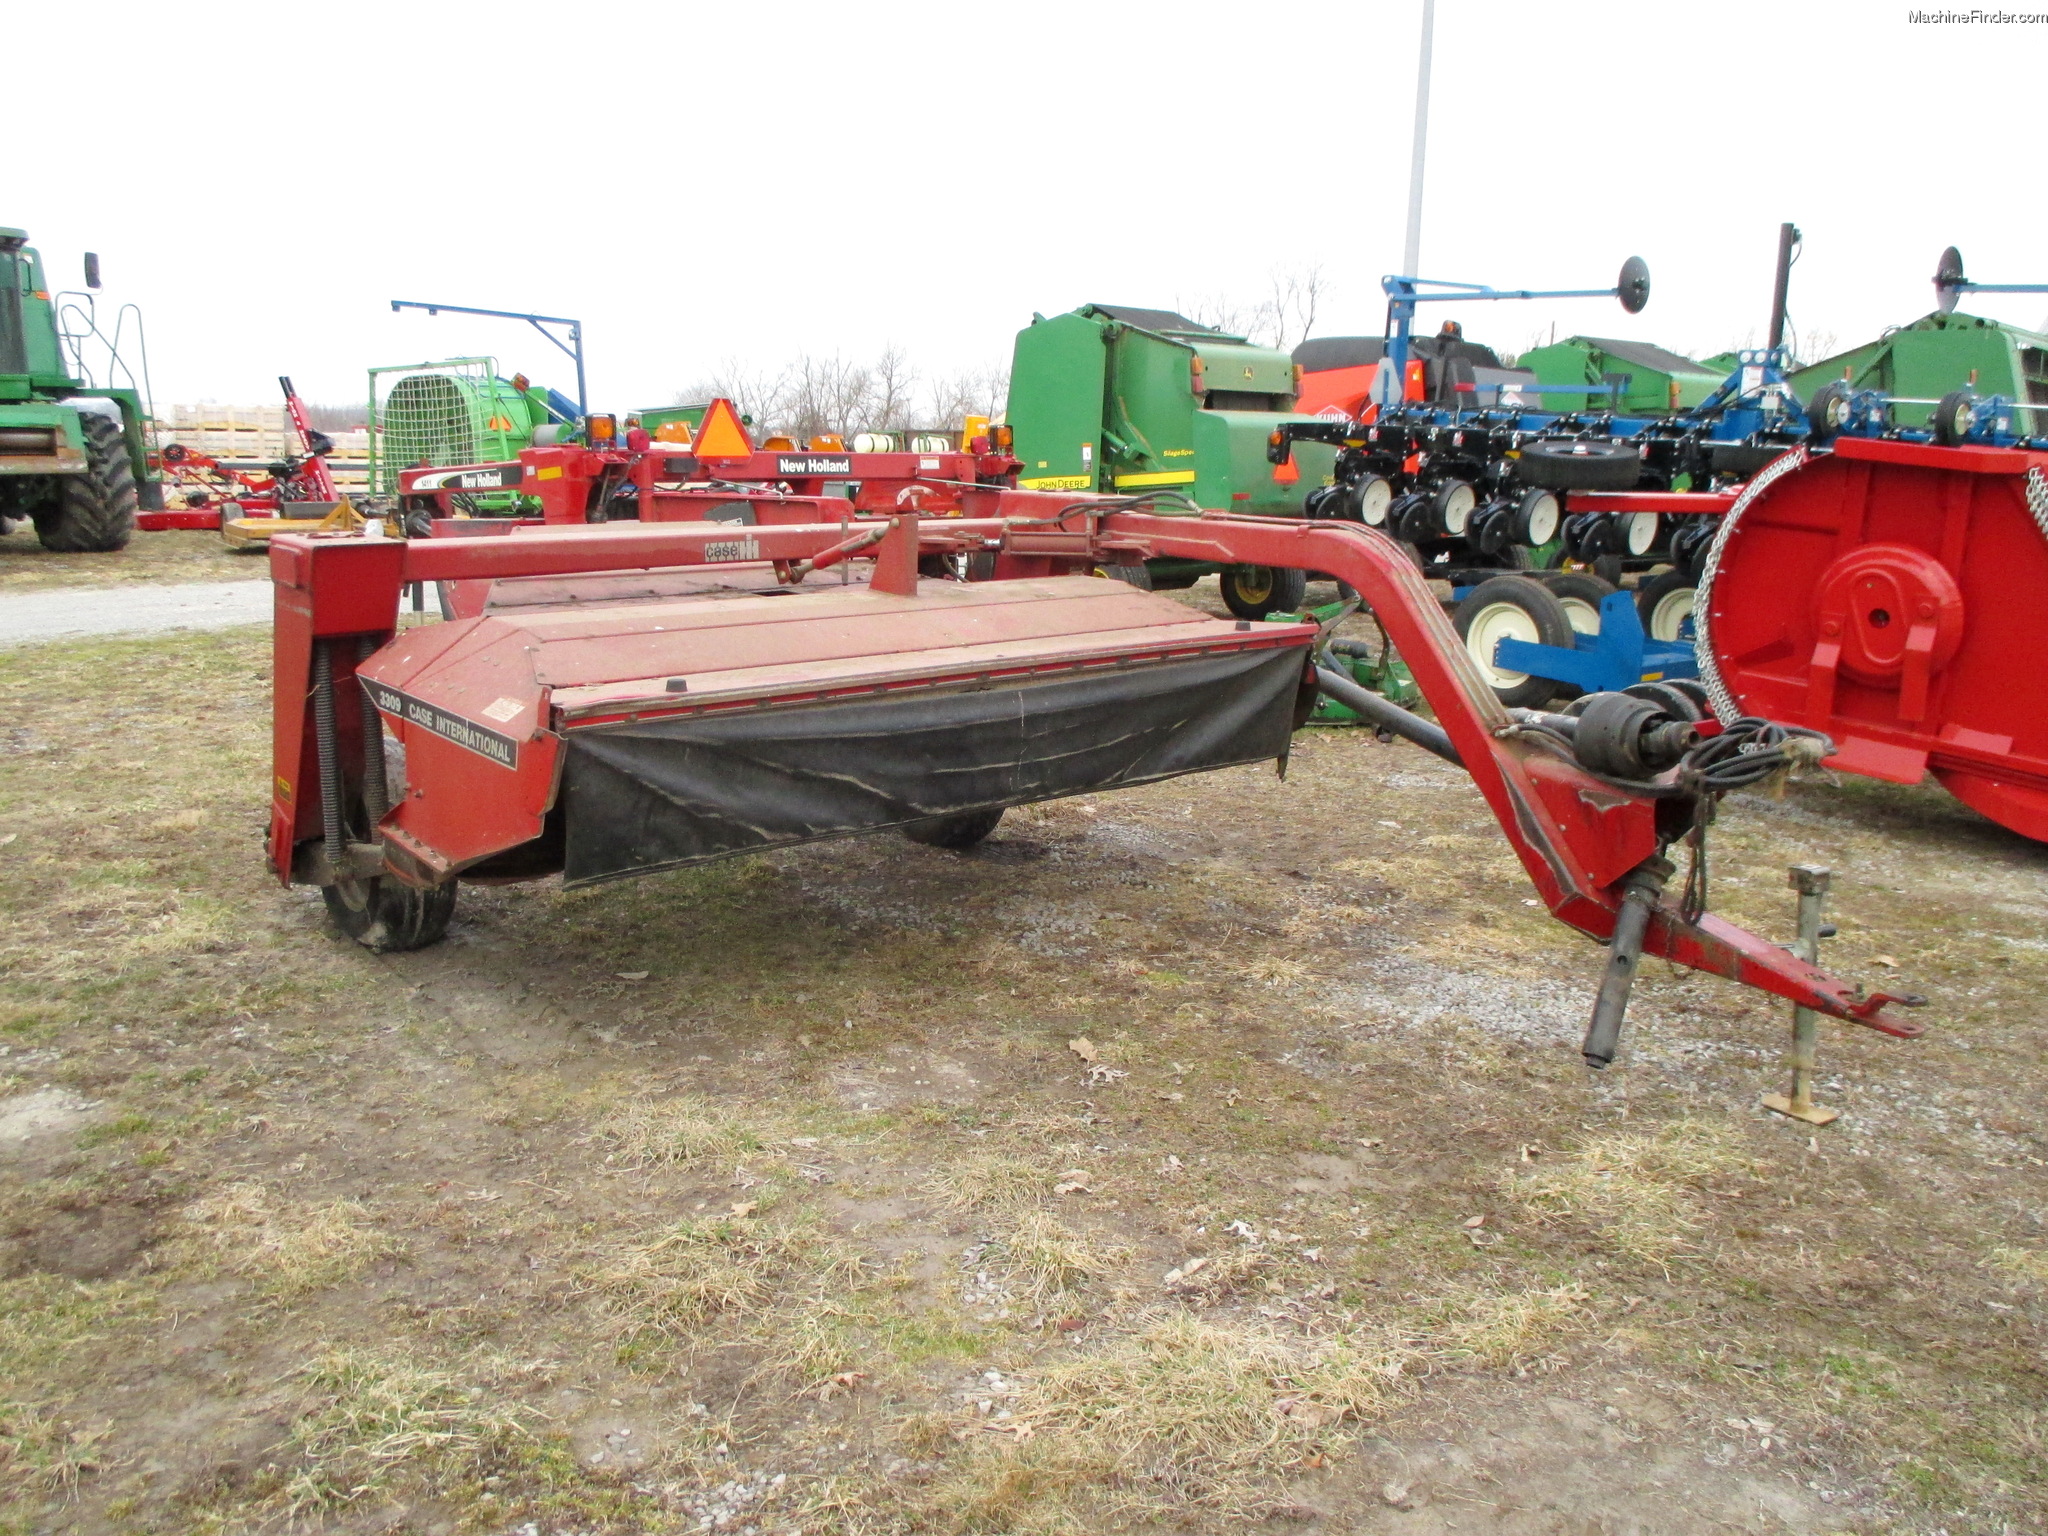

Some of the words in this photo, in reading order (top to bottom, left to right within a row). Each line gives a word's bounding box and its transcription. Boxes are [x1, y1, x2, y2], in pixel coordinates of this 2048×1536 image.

[779, 458, 806, 473] New
[807, 458, 850, 473] Holland
[461, 474, 477, 489] New
[477, 472, 502, 487] Holland
[1036, 480, 1057, 490] JOHN
[1057, 479, 1085, 489] DEERE
[379, 691, 402, 712] 3309
[409, 703, 433, 727] CASE
[436, 715, 511, 763] INTERNATIONAL
